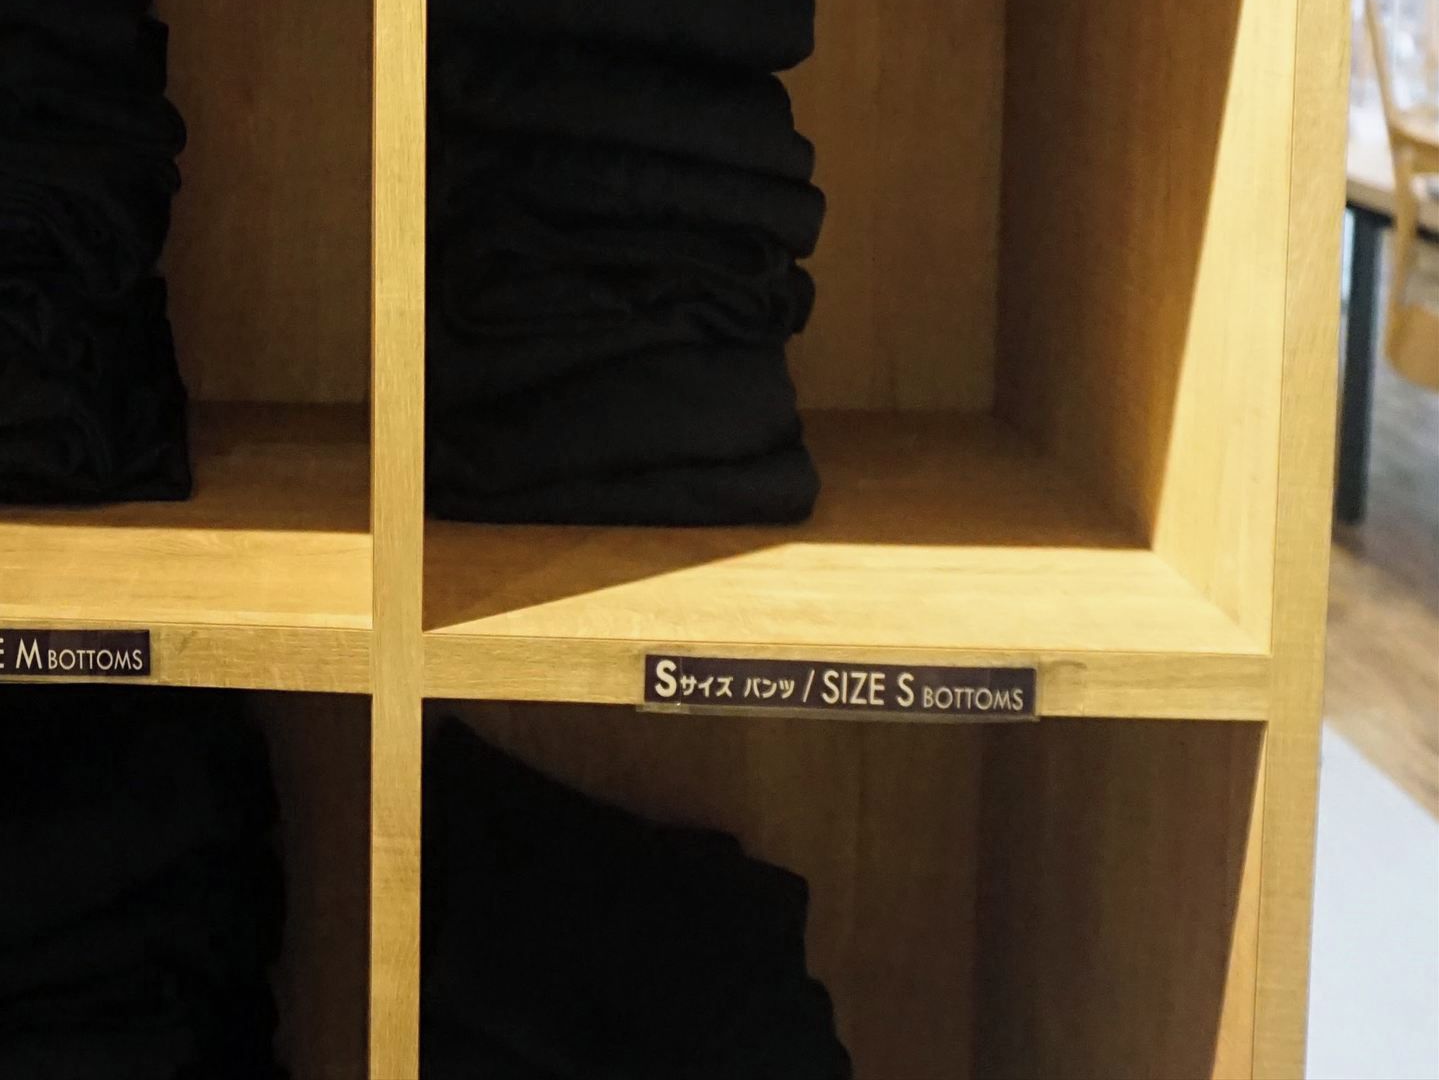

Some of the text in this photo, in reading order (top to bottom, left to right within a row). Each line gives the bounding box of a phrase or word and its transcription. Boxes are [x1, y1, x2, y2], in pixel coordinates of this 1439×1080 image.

[15, 638, 42, 670] M
[48, 649, 143, 671] BOTTOMS
[743, 676, 795, 700] パンツ
[822, 669, 886, 706] SIZE
[896, 671, 915, 708] S
[923, 687, 1024, 712] BOTTOMS
